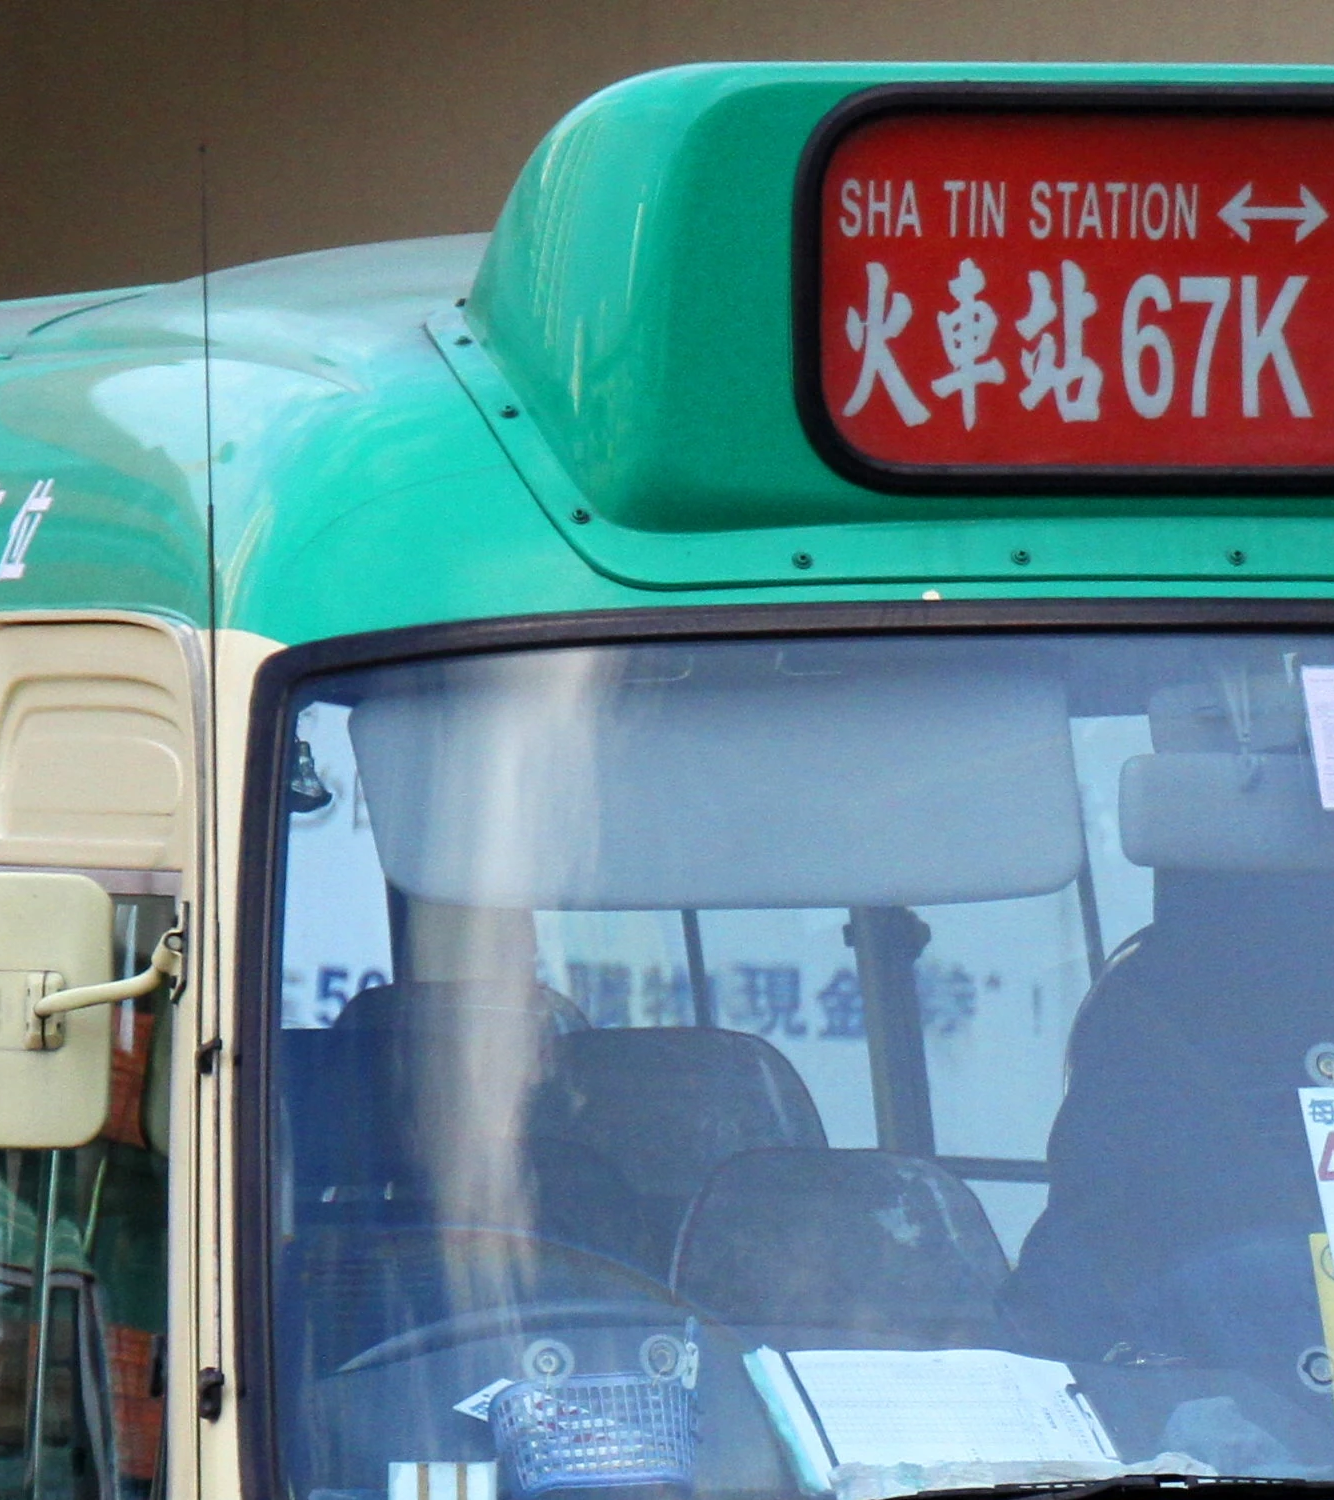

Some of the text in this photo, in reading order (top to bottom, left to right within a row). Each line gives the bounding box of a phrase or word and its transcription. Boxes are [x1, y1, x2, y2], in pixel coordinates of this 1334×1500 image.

[839, 180, 923, 239] SHA
[944, 182, 1007, 239] TIN
[1030, 181, 1200, 241] STATION
[842, 256, 1100, 432] 火車站
[1121, 274, 1314, 419] 67K
